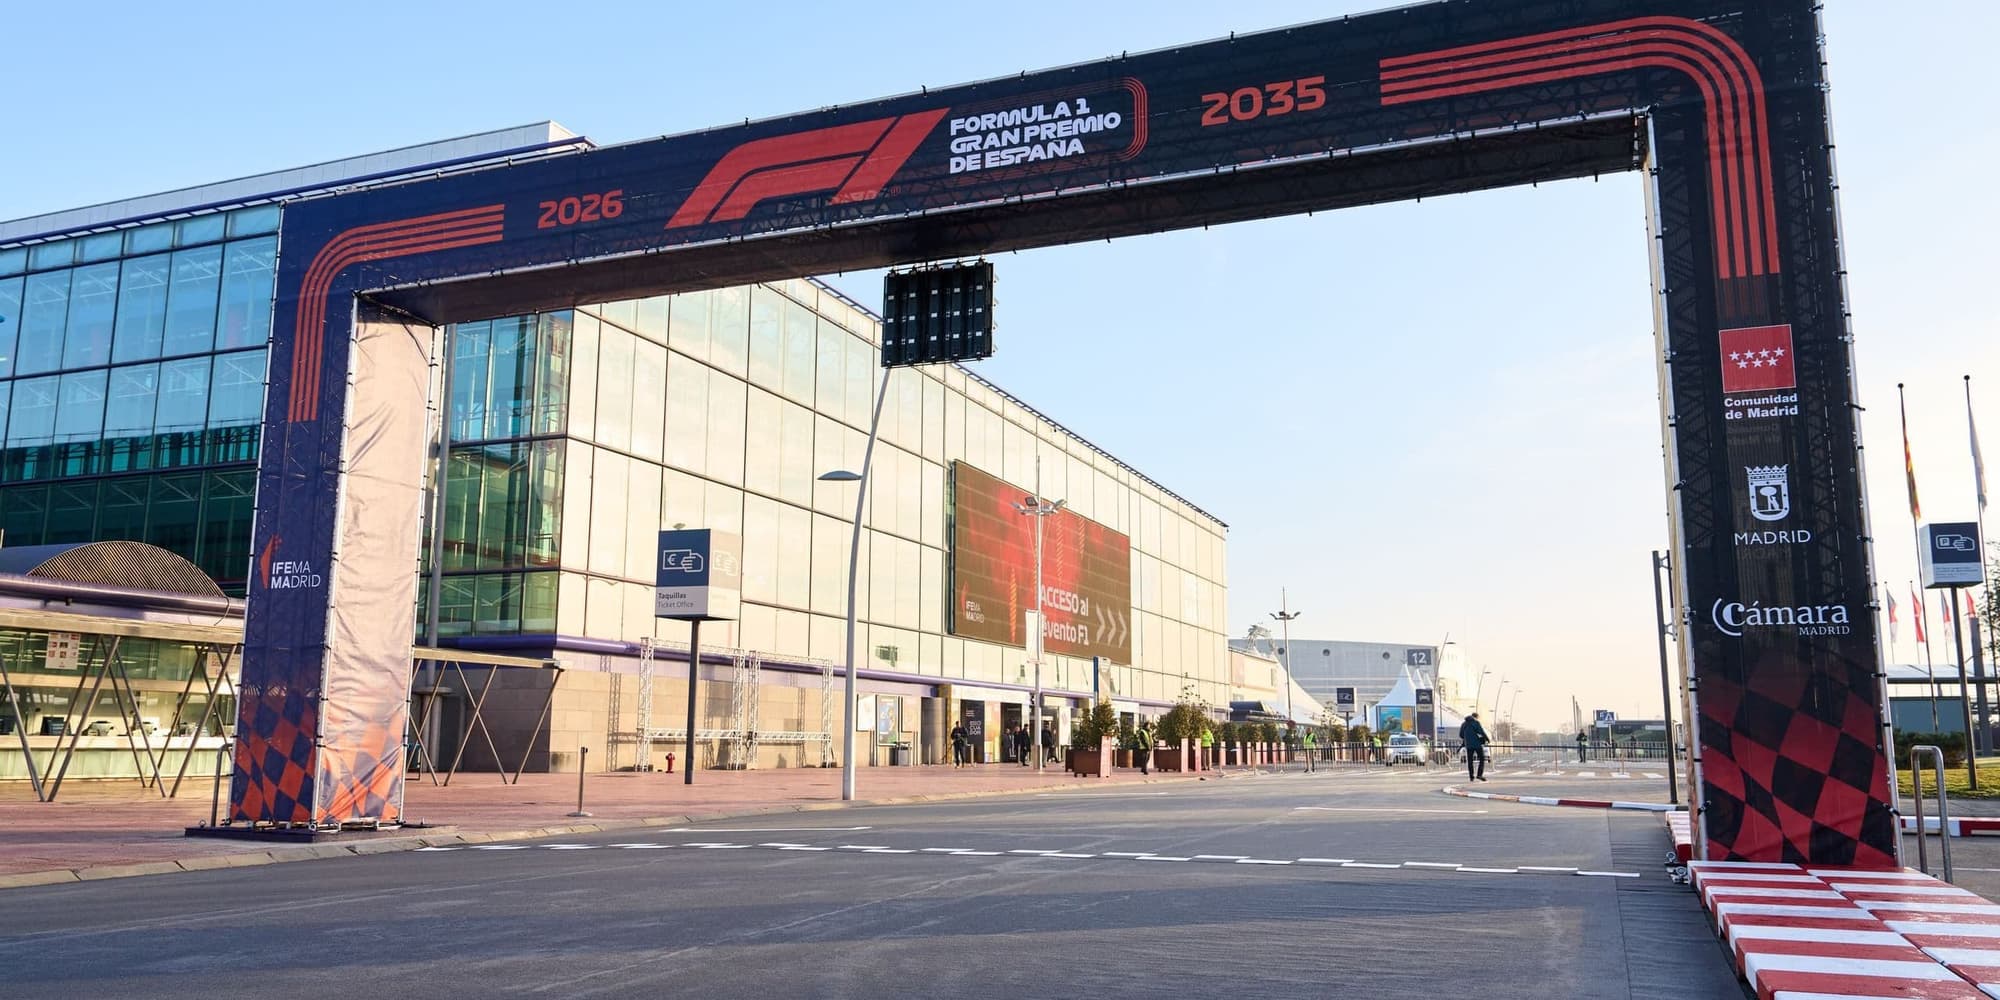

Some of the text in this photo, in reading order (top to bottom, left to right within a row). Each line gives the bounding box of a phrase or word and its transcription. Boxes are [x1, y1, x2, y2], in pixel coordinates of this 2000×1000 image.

[1201, 76, 1326, 126] 2035
[950, 98, 1090, 136] FORMULA 1
[950, 112, 1121, 154] GRAN PREMIO
[950, 138, 1085, 174] DE ESPAÑA
[537, 189, 624, 229] 2026
[1724, 393, 1798, 407] Comunidad
[1725, 405, 1798, 420] de Madrid
[1734, 529, 1811, 545] MADRID
[272, 560, 311, 575] IFEMA
[270, 574, 321, 589] MADRID
[658, 592, 687, 600] Taquillas
[676, 600, 694, 608] Office
[1041, 584, 1089, 617] ACCESO al
[1722, 600, 1849, 627] Cámara
[1043, 619, 1089, 646] evento F1
[1799, 625, 1850, 635] MADRID
[1412, 652, 1427, 664] 12
